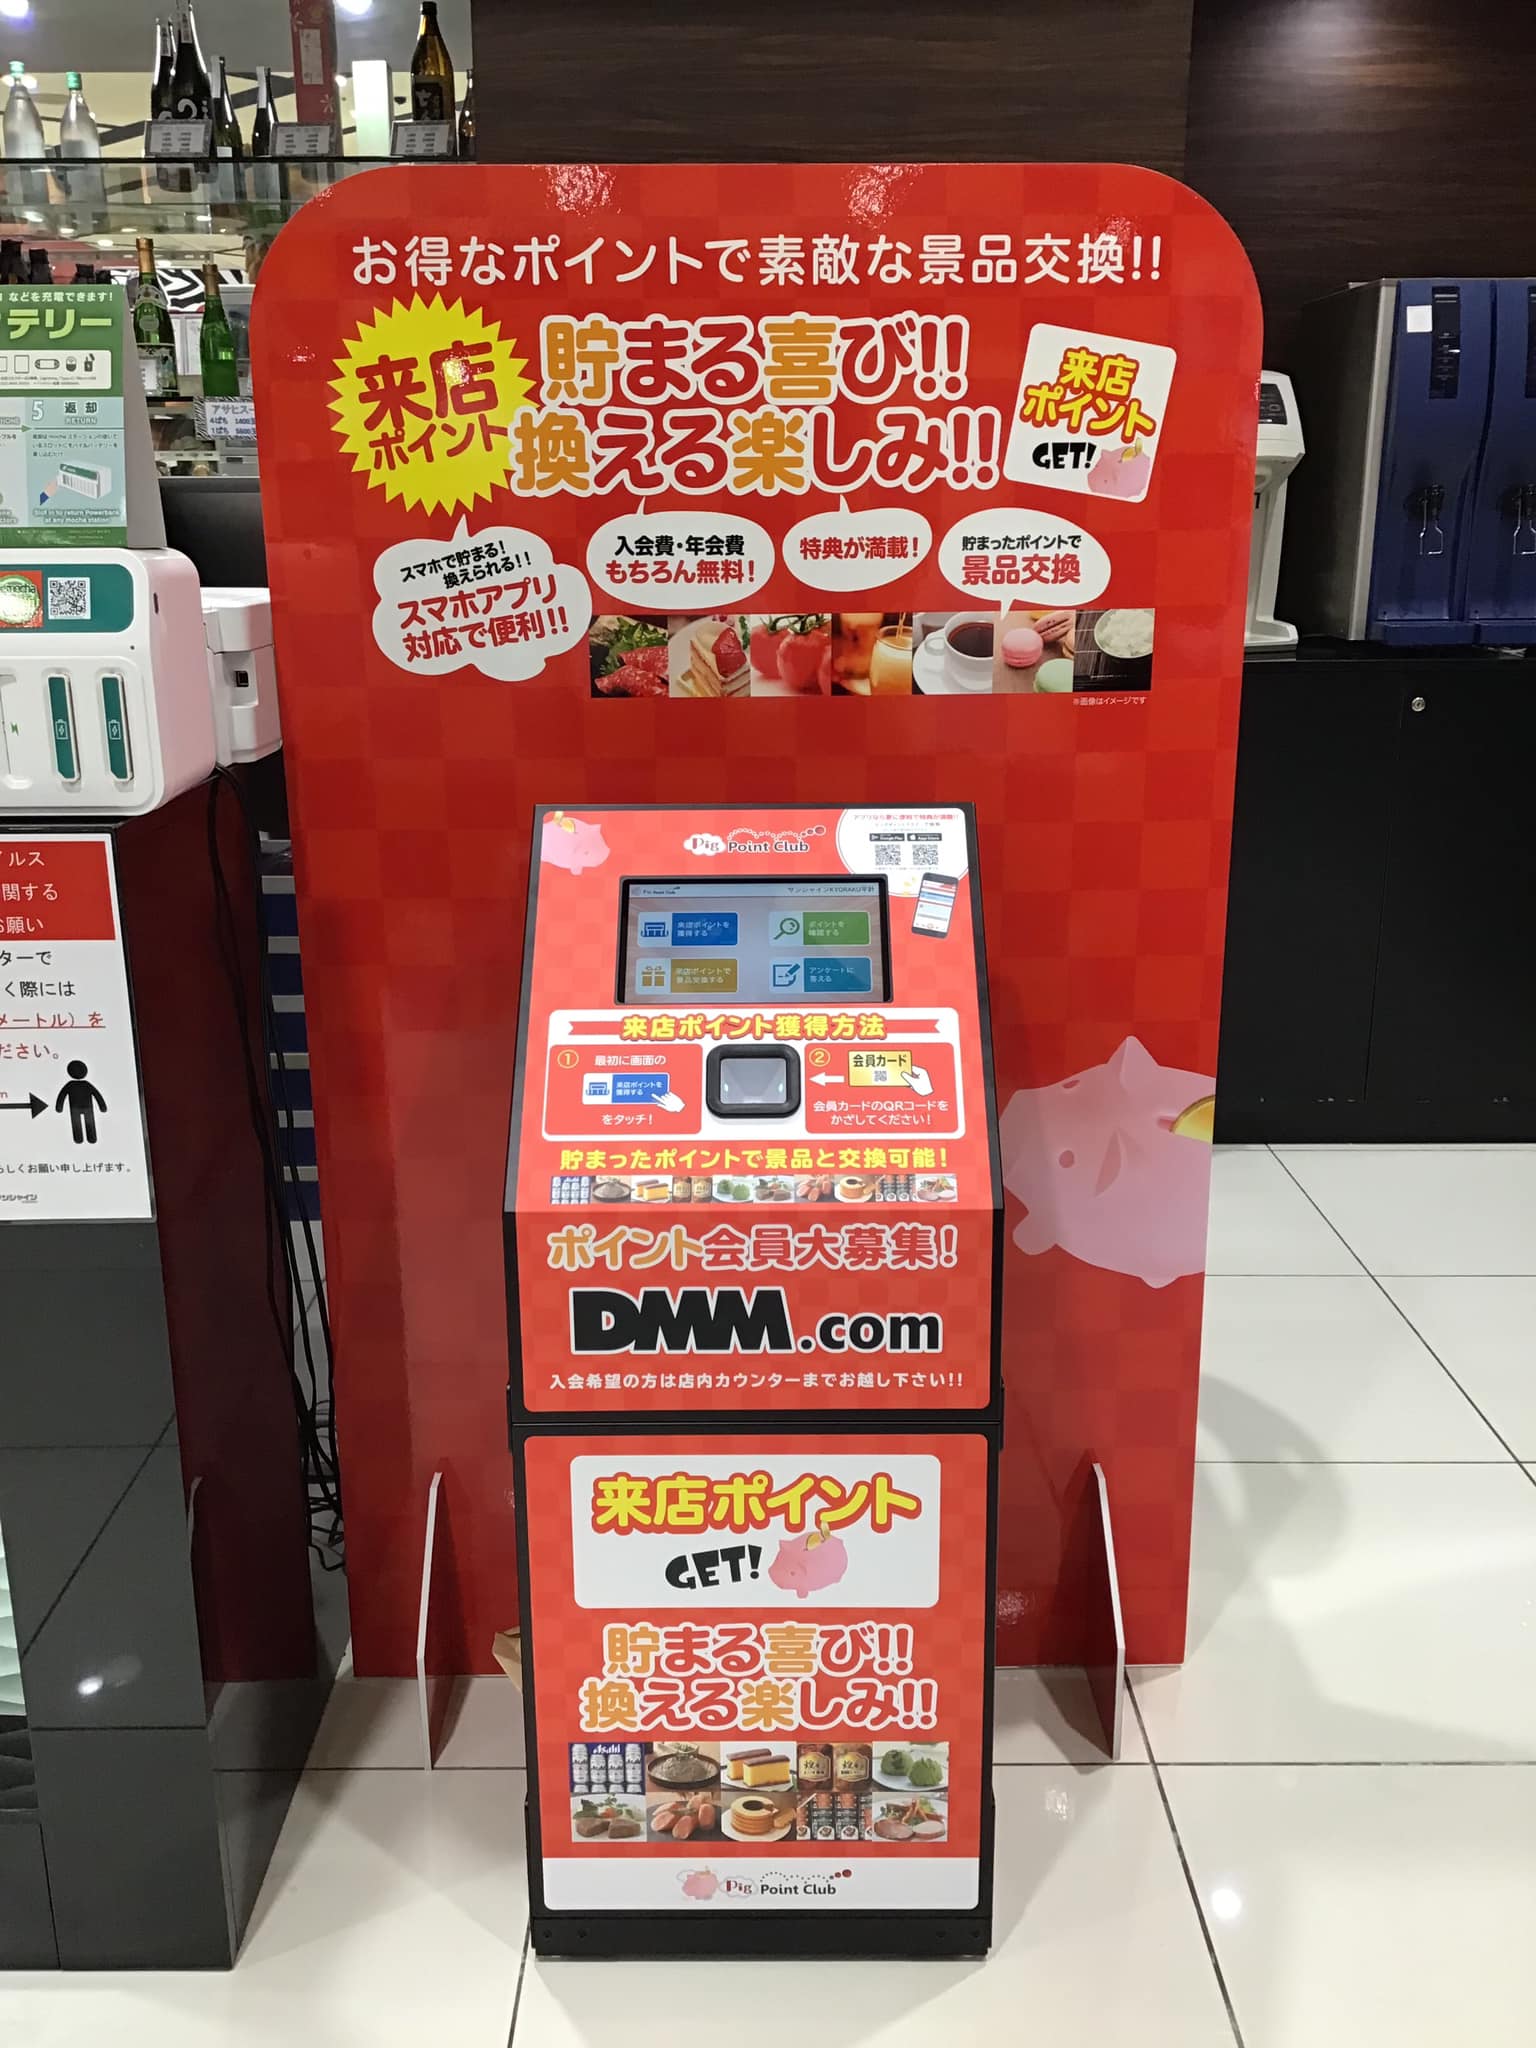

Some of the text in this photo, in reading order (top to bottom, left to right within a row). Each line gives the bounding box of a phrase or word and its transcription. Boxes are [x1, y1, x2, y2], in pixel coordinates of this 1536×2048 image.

[352, 233, 1162, 287] お得なポイントで素敵な景品交換!!
[7, 308, 112, 339] テリー
[542, 313, 968, 403] 貯まる喜び!!
[1059, 348, 1138, 397] 来店
[354, 339, 500, 431] 来店
[31, 400, 44, 420] 5
[1021, 384, 1156, 440] ポイント
[368, 413, 509, 471] ポイント
[511, 408, 1000, 494] 換える楽しみ!!
[1032, 441, 1098, 470] GET!
[614, 535, 745, 557] 入会費・年会費
[799, 536, 920, 561] 特典が満載!
[961, 534, 1082, 552] 貯まったポイントで
[399, 540, 507, 583] スマホで貯まる!
[443, 551, 532, 590] 換えられる!!
[604, 558, 756, 585] もちろん無料!
[961, 553, 1081, 586] 景品交換
[397, 574, 558, 630] スマホアプリ
[402, 606, 570, 663] 対応で便利!!
[0, 850, 45, 867] ルス
[692, 837, 809, 852] Pig Point Club
[2, 883, 58, 901] 関する
[4, 980, 76, 998] く際には
[620, 1013, 887, 1040] 来店ポイント獲得方法
[594, 1055, 667, 1067] 最初に画面の
[852, 1054, 908, 1068] 会員カード
[602, 1114, 654, 1125] をタッチ!
[813, 1100, 949, 1112] 会員カードのQRコードを
[830, 1114, 932, 1126] かざしてください!
[559, 1148, 950, 1171] 貯まったポイントで景品と交換可能!
[548, 1224, 958, 1271] ポイント会員大募集!
[568, 1286, 943, 1354] DMM.com
[550, 1372, 963, 1390] 入会希望の方は店内カウンターまでお越し下さい!!
[594, 1471, 920, 1530] 来店ポイント
[664, 1543, 762, 1590] GET!
[604, 1622, 914, 1677] 貯まる喜び!!
[582, 1678, 937, 1732] 換える楽しみ!!
[726, 1879, 837, 1895] Pig Point Club
